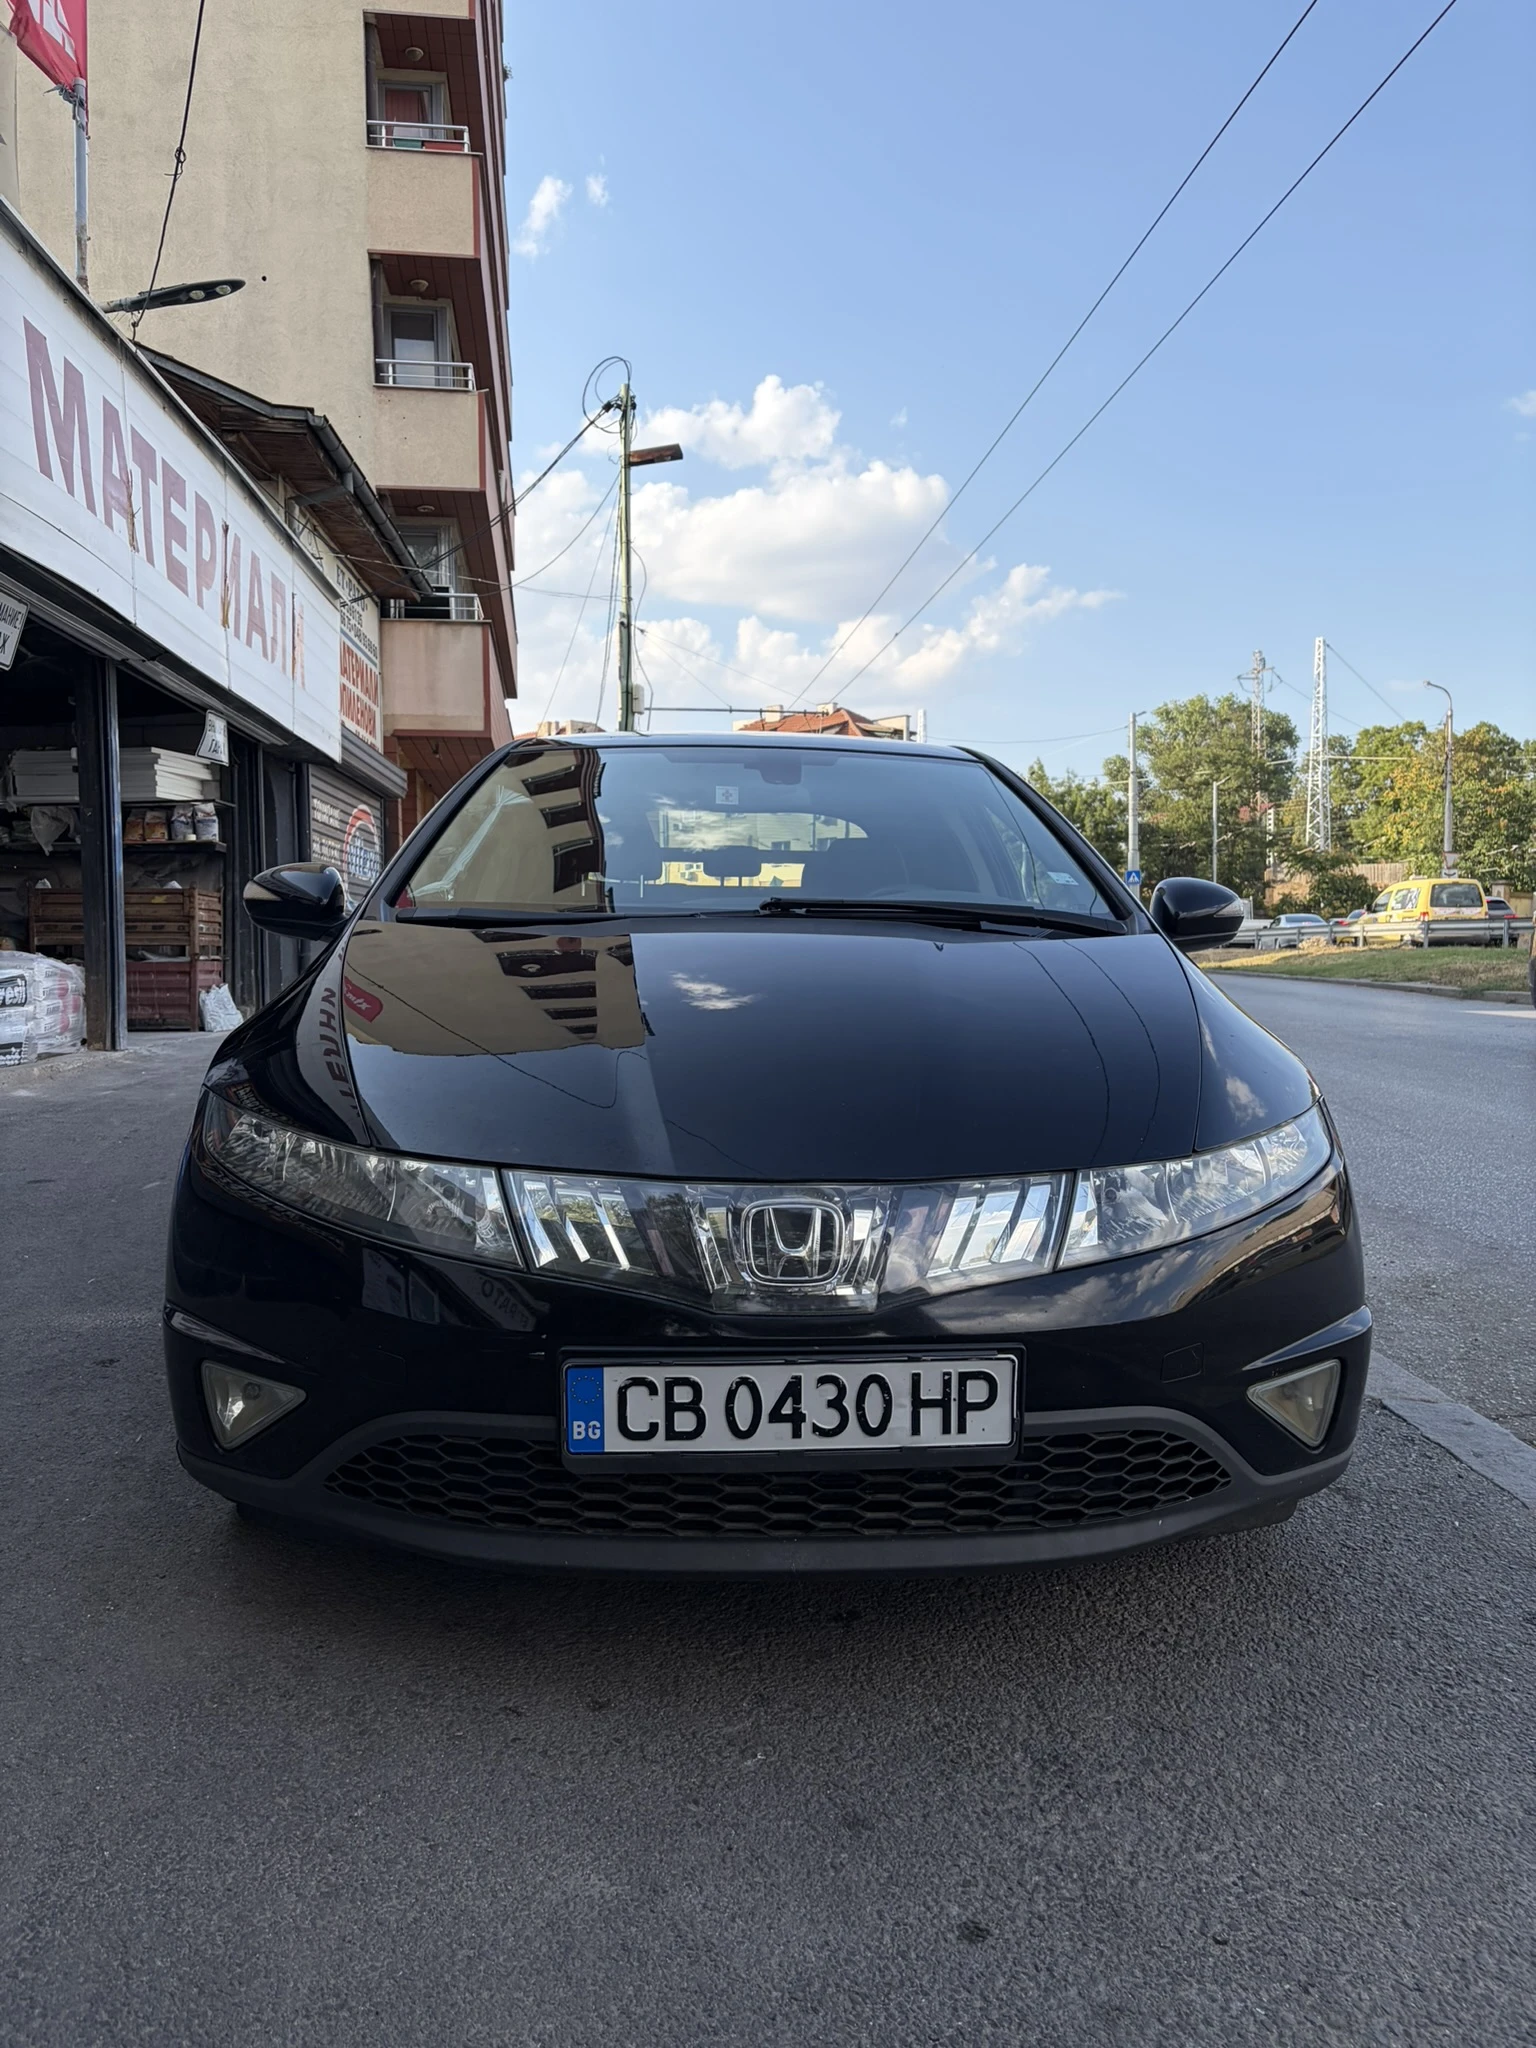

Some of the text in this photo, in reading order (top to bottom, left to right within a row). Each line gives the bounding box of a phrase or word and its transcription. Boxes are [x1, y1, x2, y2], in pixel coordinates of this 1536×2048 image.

[617, 1369, 1000, 1442] CB 0430 HP
[573, 1420, 601, 1440] BG
